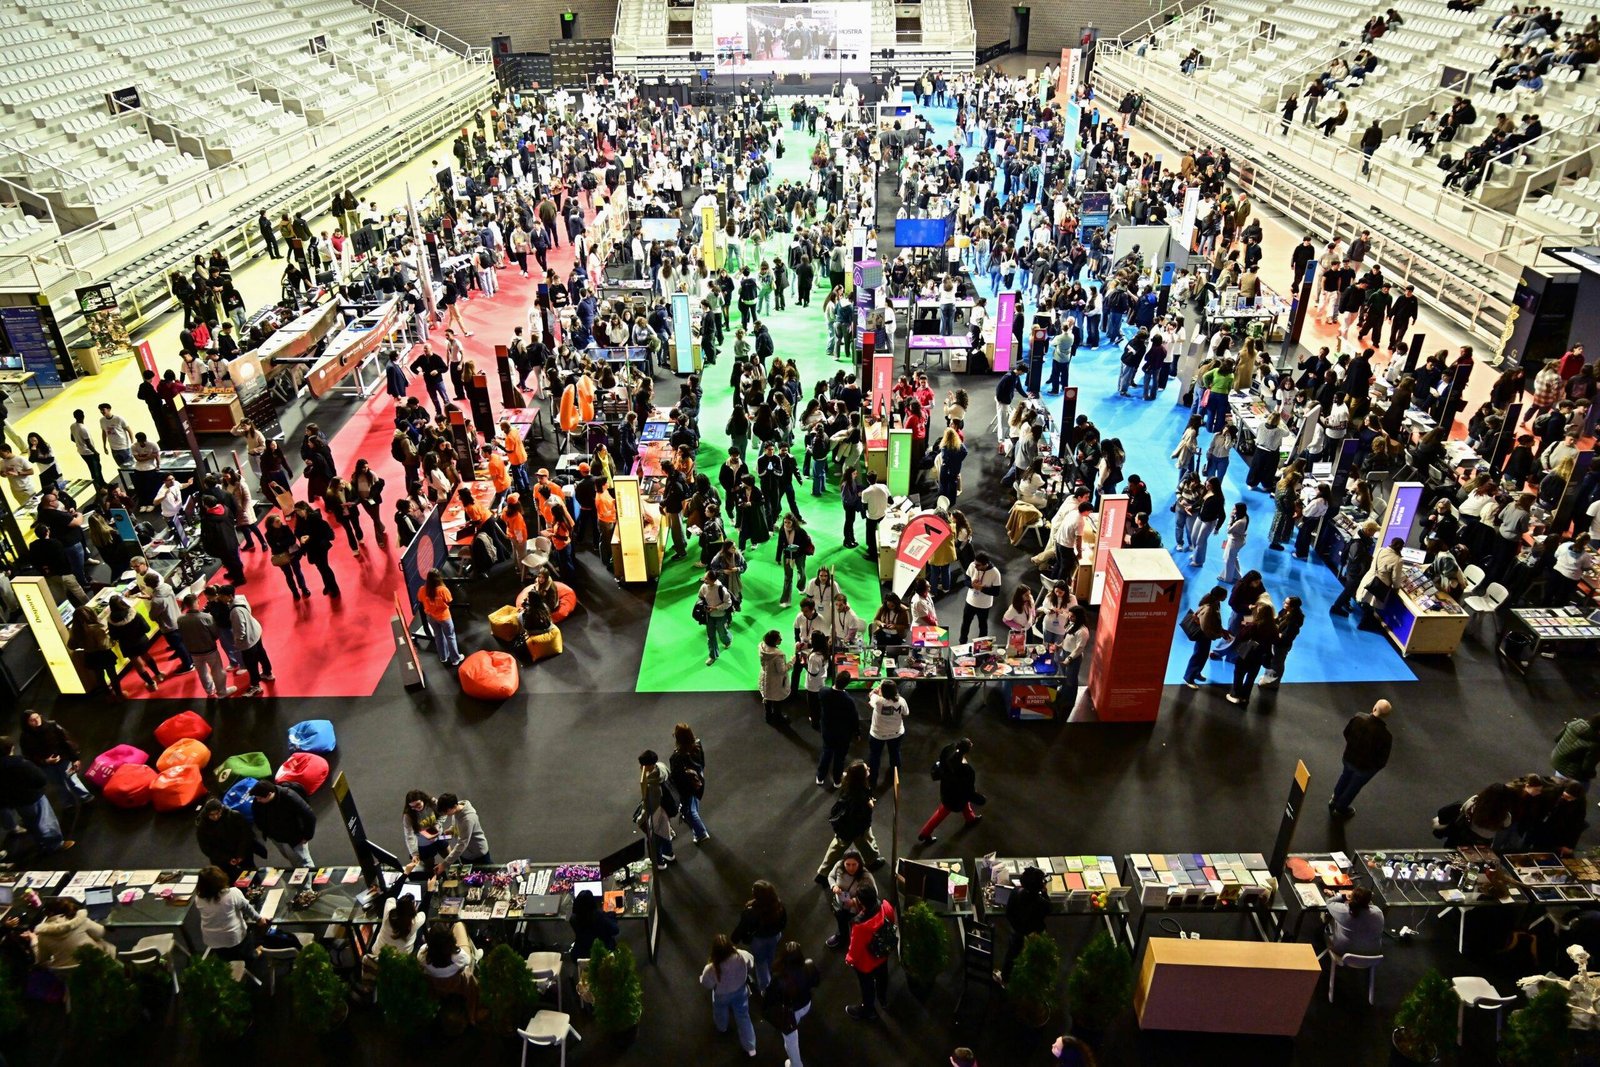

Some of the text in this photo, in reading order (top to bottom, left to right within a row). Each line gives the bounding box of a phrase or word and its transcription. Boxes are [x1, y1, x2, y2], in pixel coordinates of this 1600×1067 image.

[1105, 508, 1115, 538] Economia
[1394, 506, 1405, 526] Letras
[25, 594, 42, 623] Desporto
